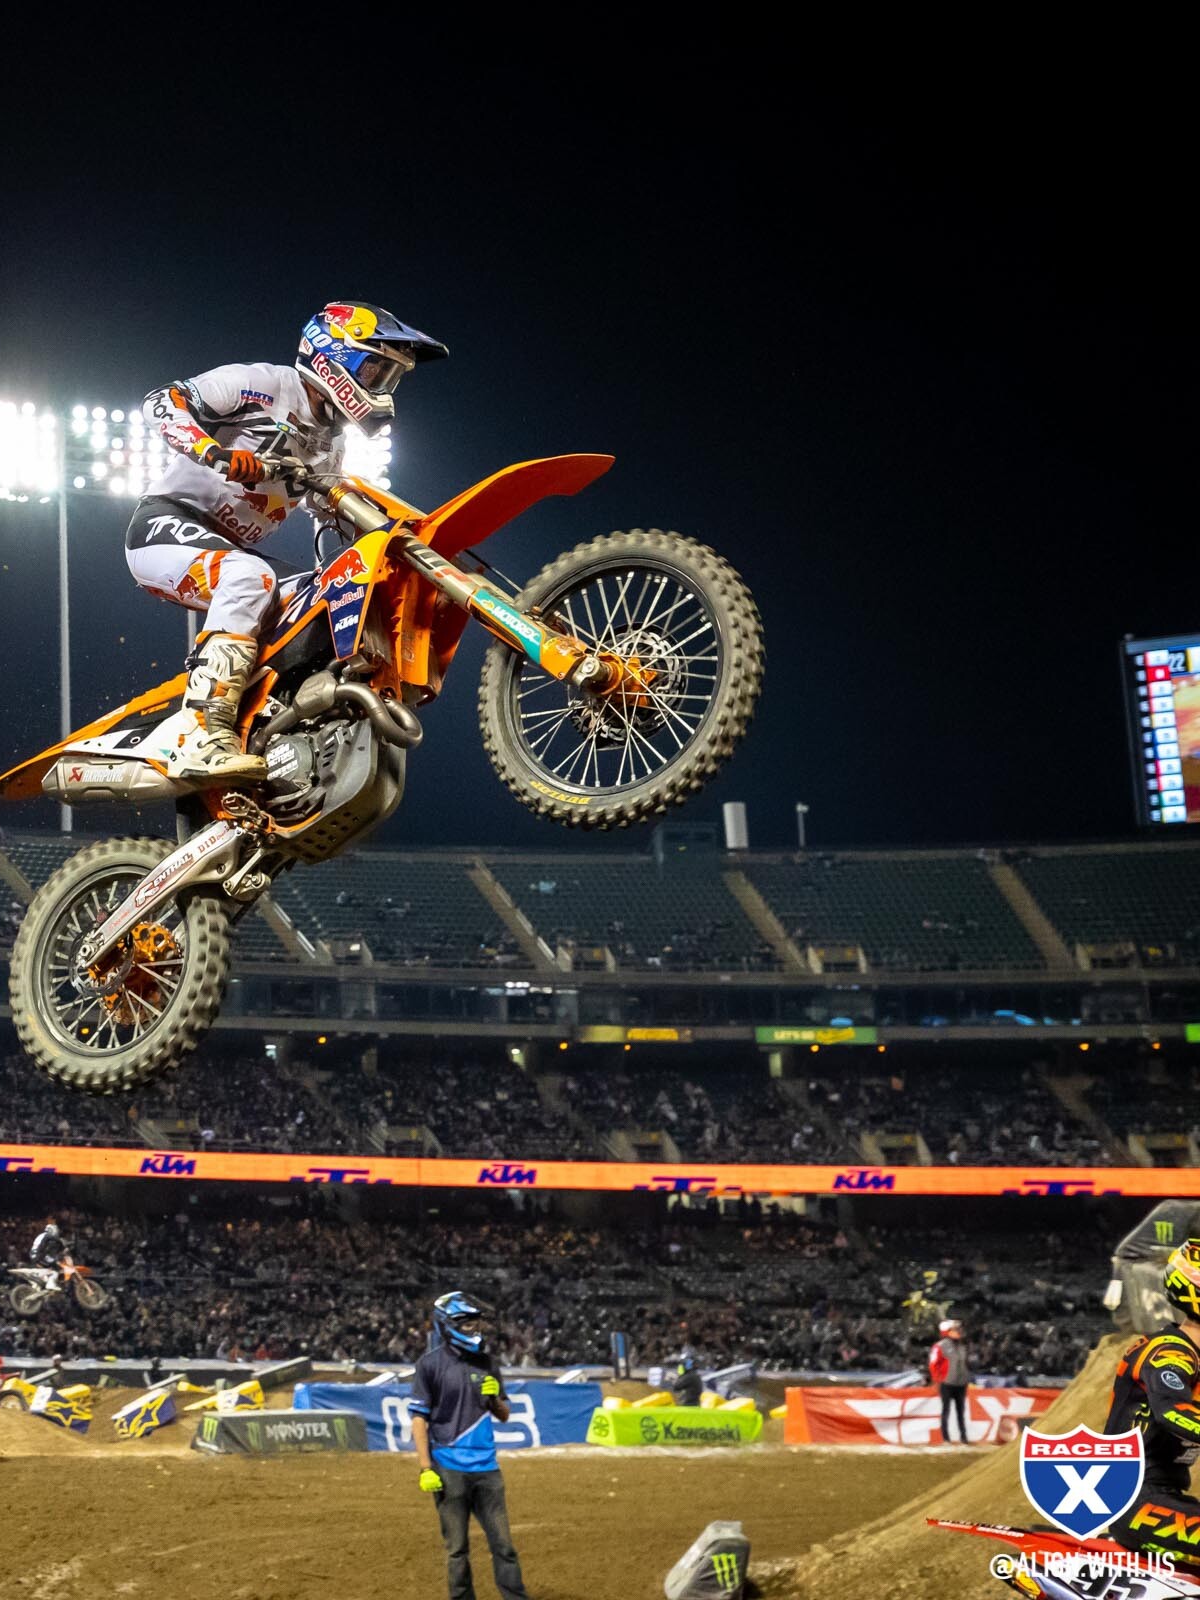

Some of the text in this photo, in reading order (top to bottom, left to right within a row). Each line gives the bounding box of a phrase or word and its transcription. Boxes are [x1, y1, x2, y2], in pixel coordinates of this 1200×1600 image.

[240, 389, 274, 404] PARTS
[334, 614, 359, 633] KTM
[530, 780, 593, 805] DUNLOP
[197, 836, 217, 853] DID
[140, 1153, 197, 1176] KTM
[477, 1164, 537, 1185] KTM
[832, 1169, 896, 1190] KTM
[265, 1421, 332, 1441] MONSTER
[660, 1421, 741, 1443] Kawasaki
